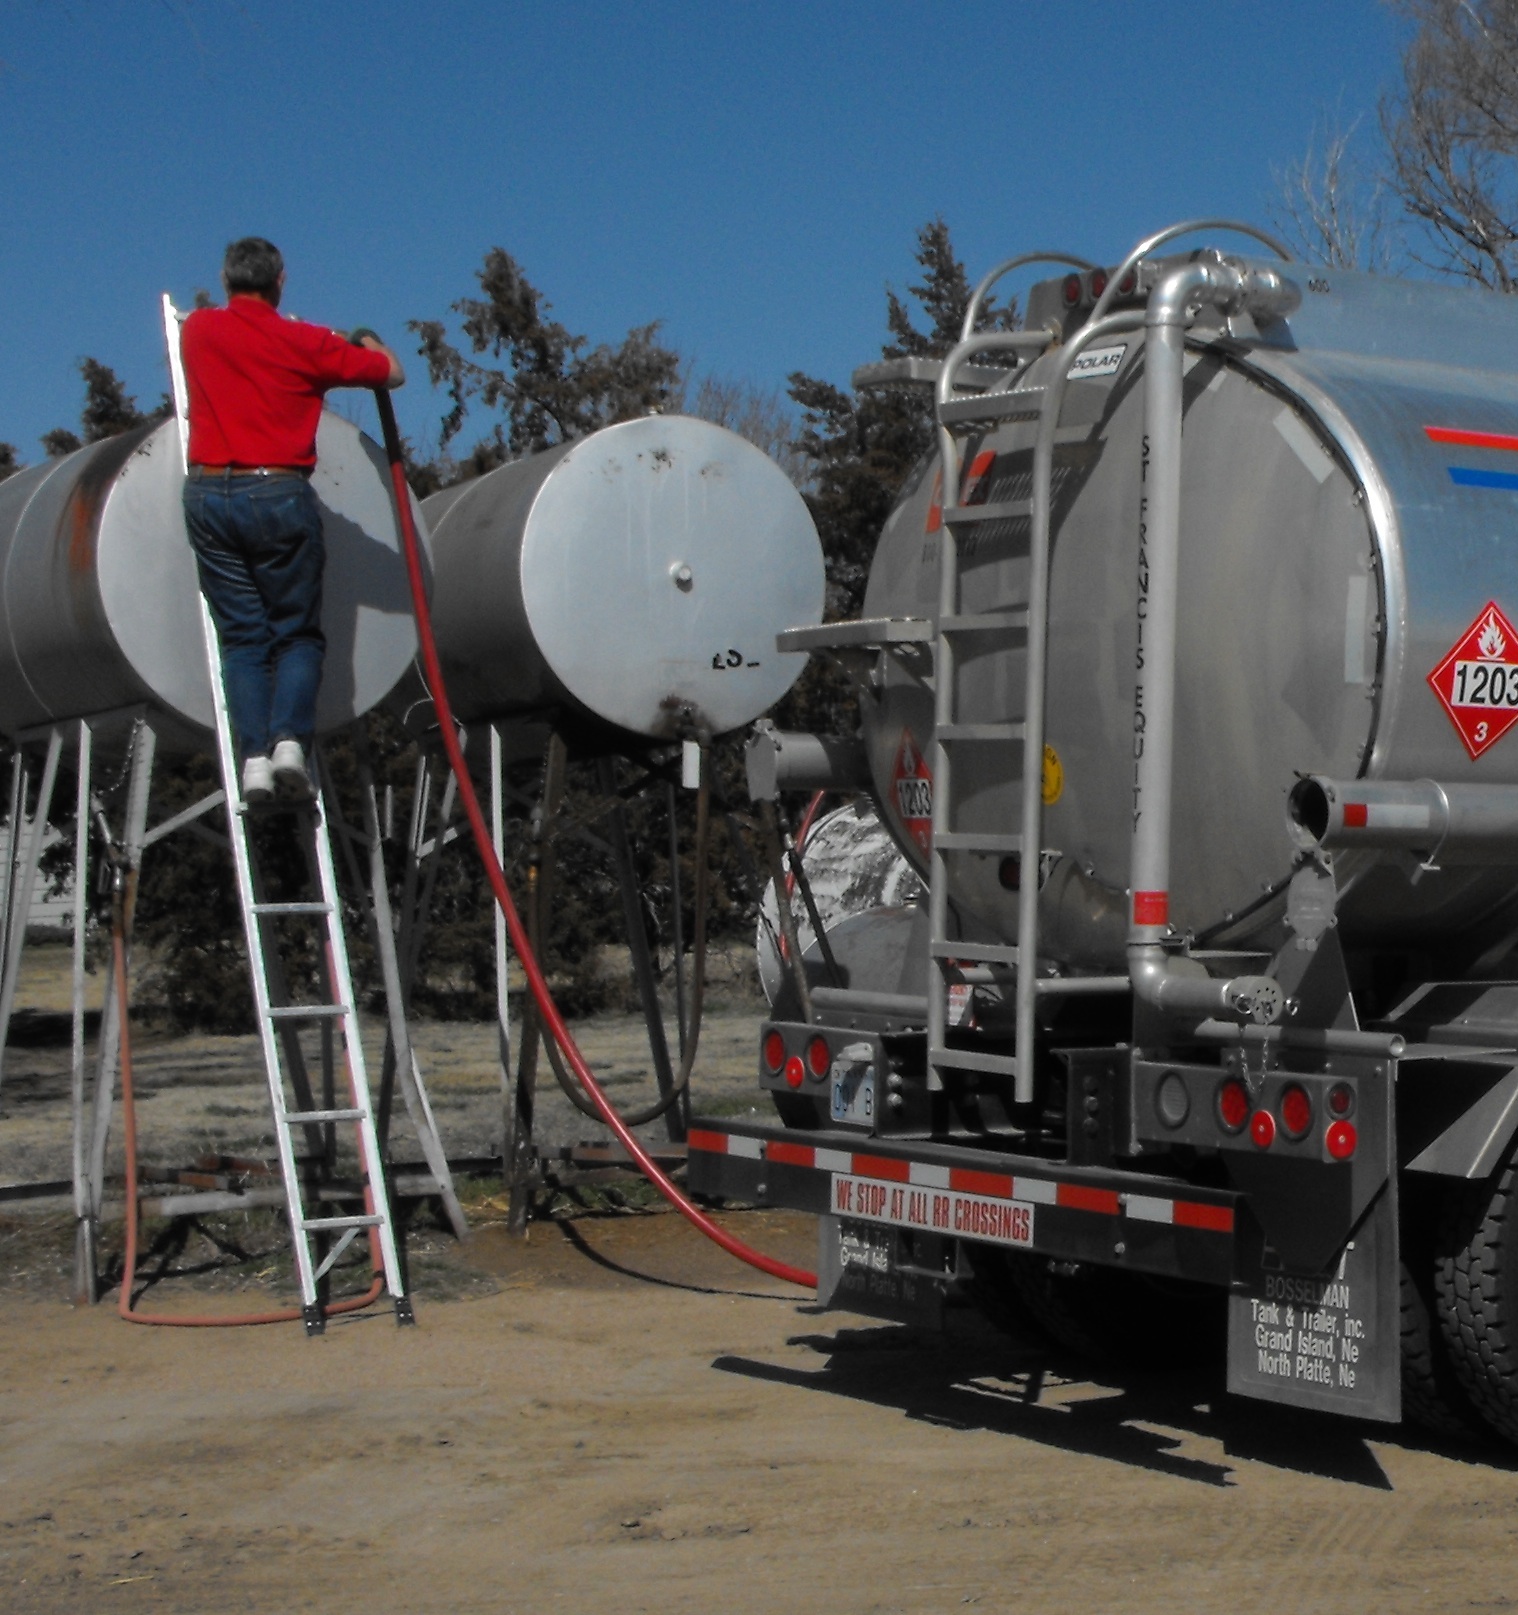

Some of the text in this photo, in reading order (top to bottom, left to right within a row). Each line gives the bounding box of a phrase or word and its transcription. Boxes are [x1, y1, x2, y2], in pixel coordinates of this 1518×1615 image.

[1073, 354, 1121, 370] POLAR
[1136, 498, 1149, 670] FRANCIS
[1473, 720, 1489, 742] 3
[1132, 684, 1146, 833] EQUITY
[899, 781, 932, 816] 1203
[836, 1178, 1030, 1242] WE STOP AT ALL RR CROSSINGS
[1250, 1298, 1279, 1326] Tank
[1285, 1304, 1294, 1328] &
[1344, 1313, 1365, 1339] inc.
[1255, 1323, 1359, 1363] Grand Island, Ne
[1258, 1349, 1356, 1388] North Platte, Ne
